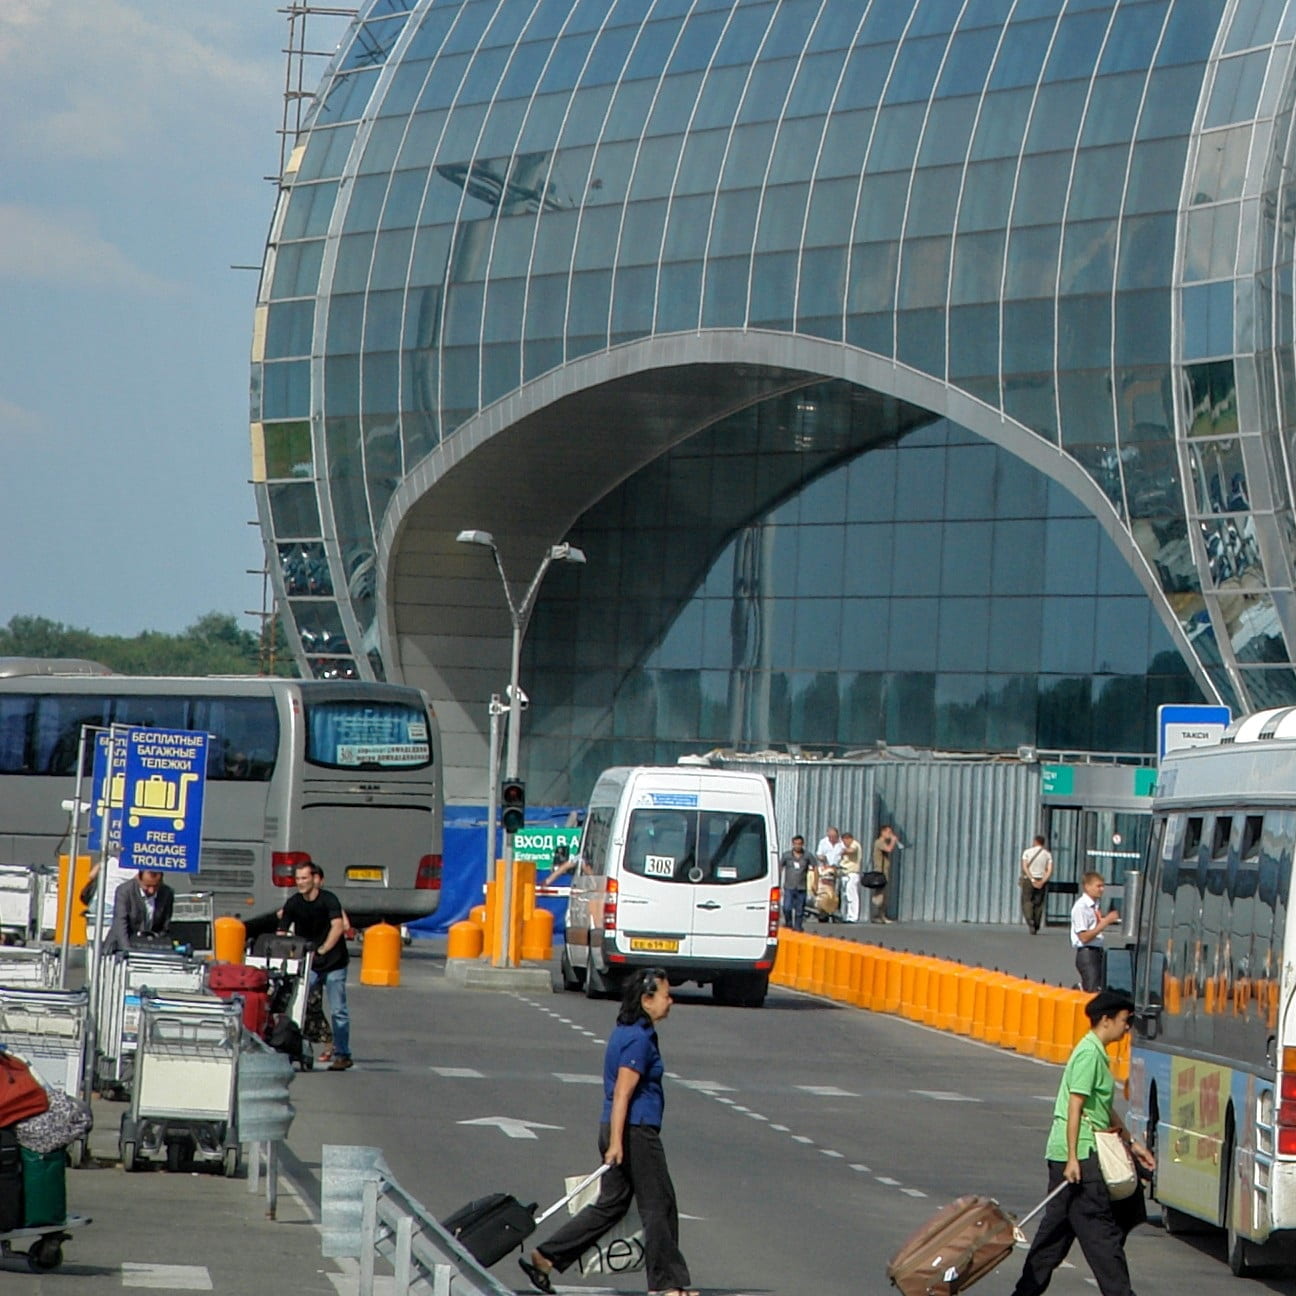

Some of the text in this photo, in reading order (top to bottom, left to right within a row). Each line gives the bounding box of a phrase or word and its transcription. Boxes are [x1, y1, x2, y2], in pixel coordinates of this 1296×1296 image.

[132, 732, 203, 746] БЕСПЛАТНЫЕ
[1182, 731, 1209, 739] ТАКСИ
[137, 745, 196, 758] БАГАЖНЫЕ
[141, 757, 191, 770] ТЕЛЕЖКИ
[146, 831, 175, 843] FREE
[514, 835, 554, 850] ВХОД
[133, 842, 187, 856] BAGGAGE
[132, 854, 187, 868] TROLLEYS
[647, 857, 672, 875] 308
